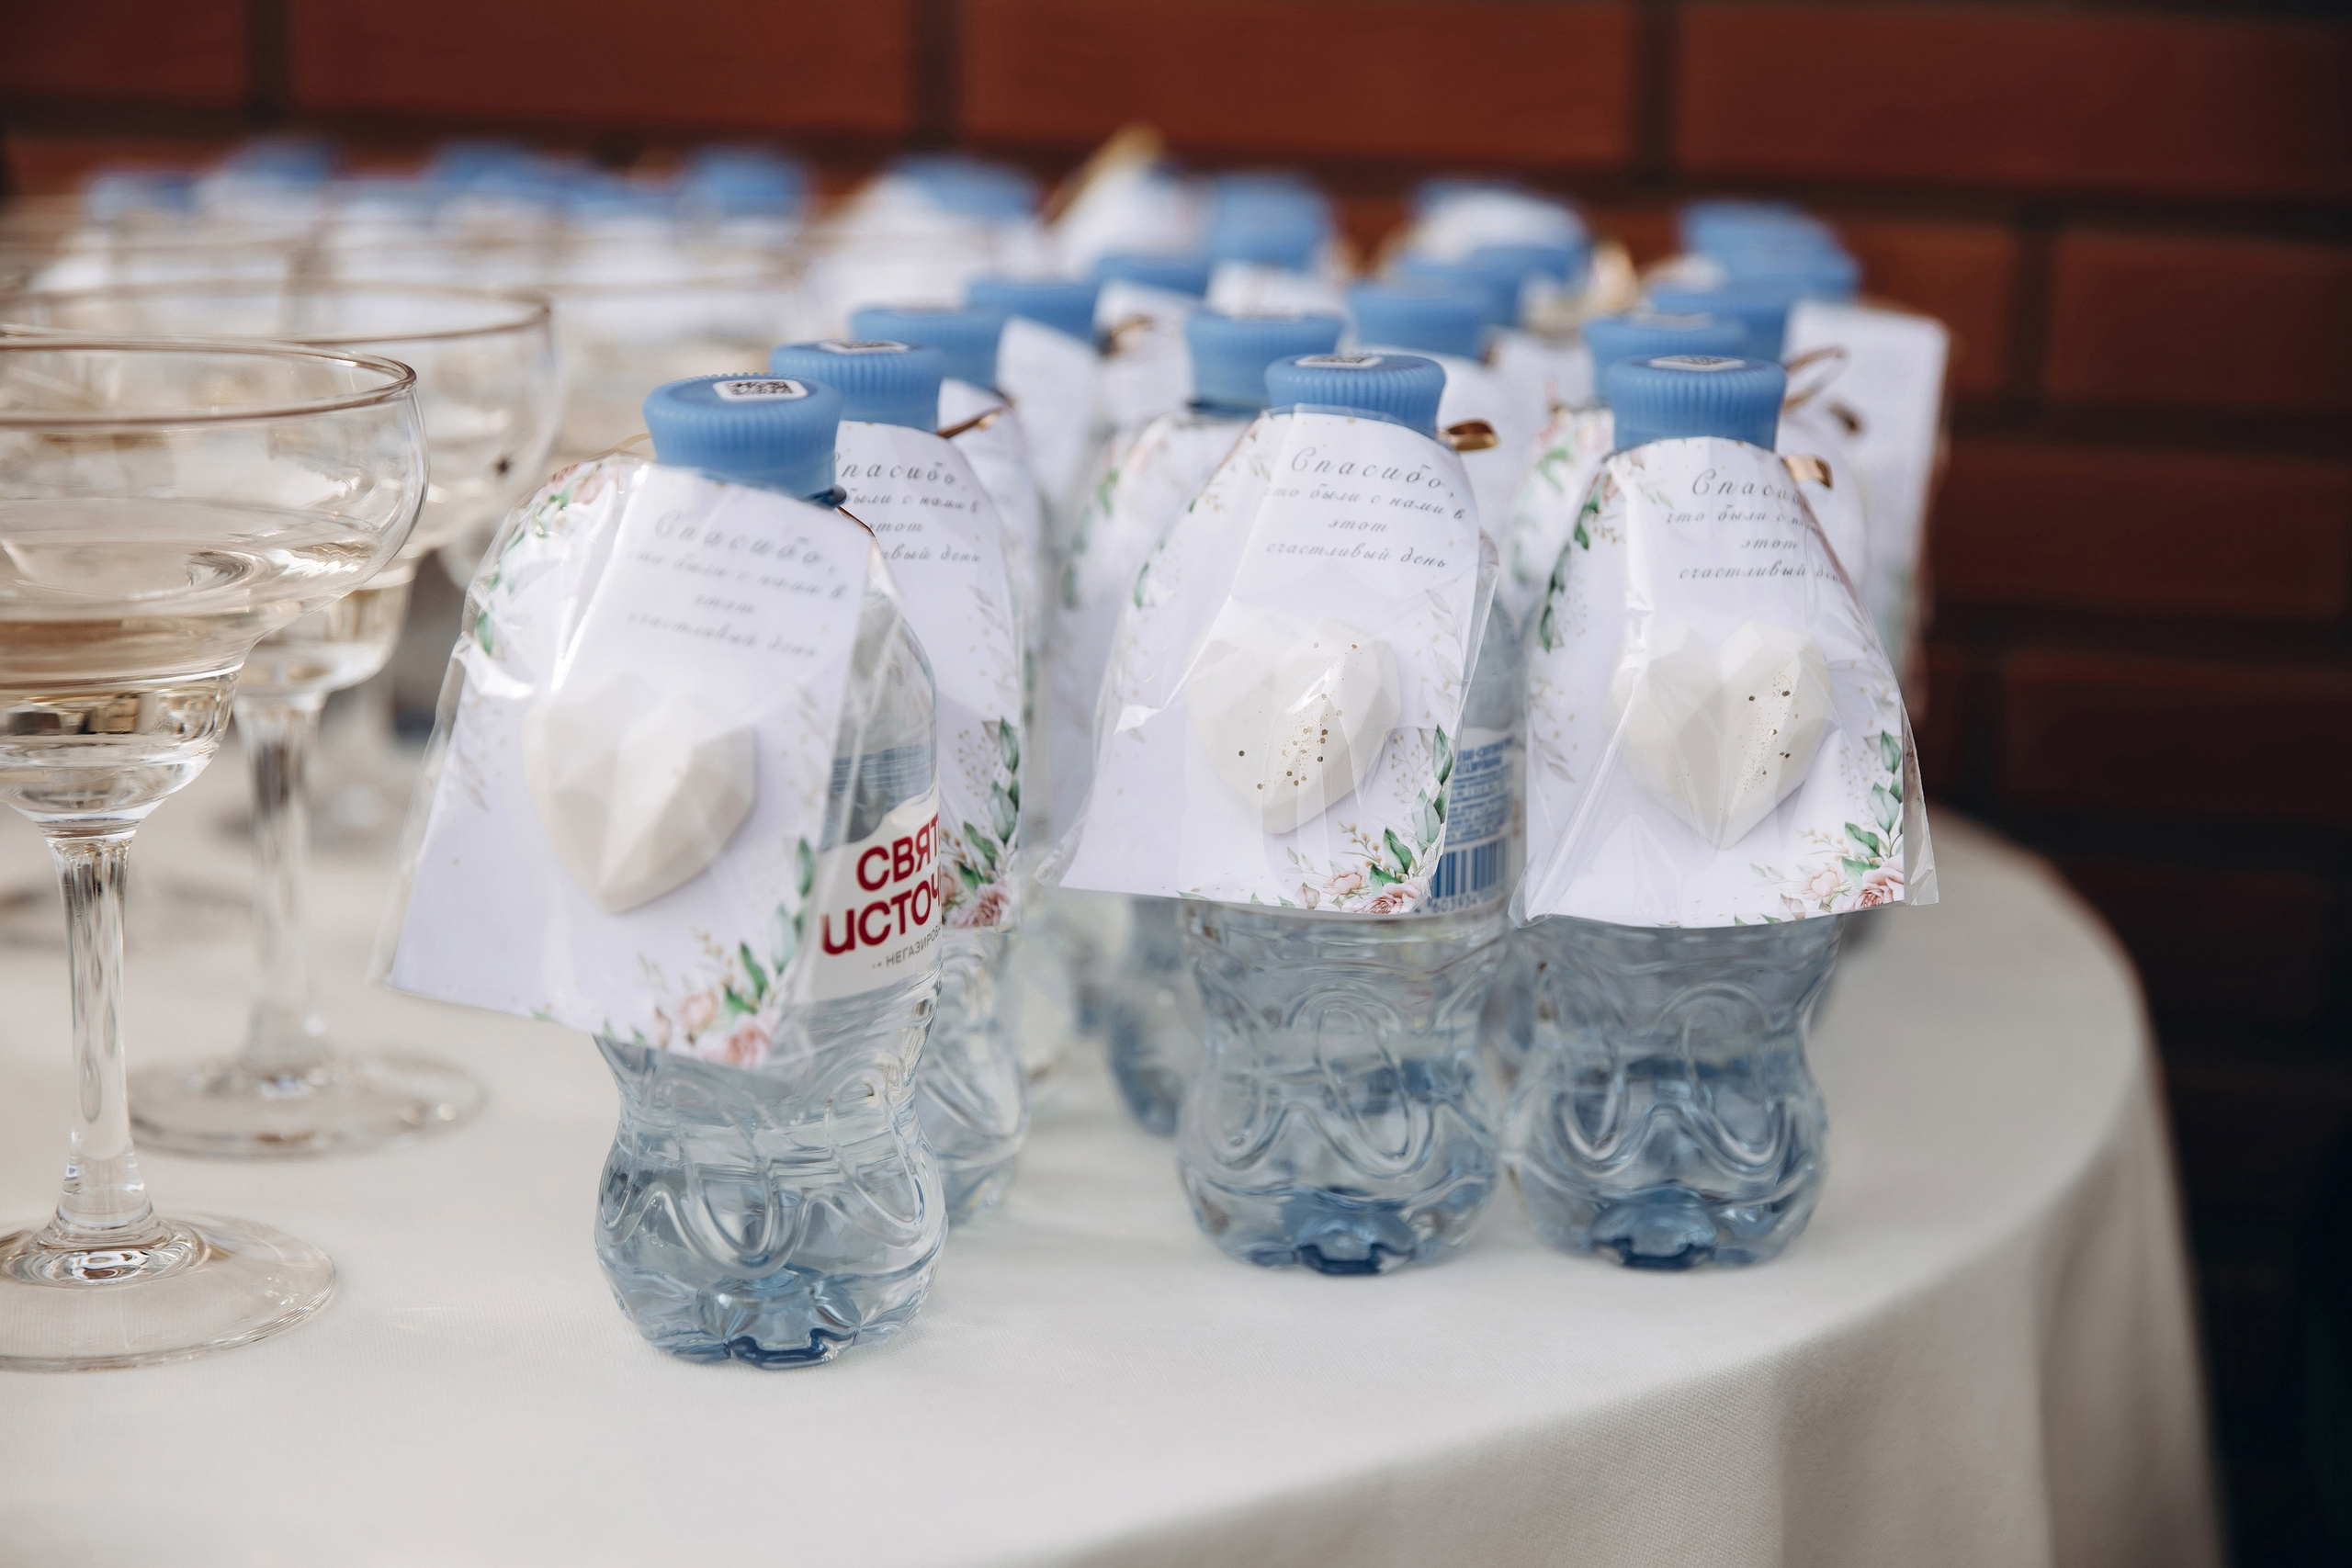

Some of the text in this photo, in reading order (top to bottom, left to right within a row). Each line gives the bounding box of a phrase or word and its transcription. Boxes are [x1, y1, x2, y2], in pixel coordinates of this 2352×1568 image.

[1291, 446, 1454, 498] Спасибо,
[901, 494, 913, 505] с
[1310, 483, 1362, 502] были
[1370, 494, 1382, 505] с
[1389, 497, 1446, 514] нами
[1453, 507, 1467, 521] в
[1717, 502, 1769, 523] были
[1327, 517, 1390, 534] этот
[1266, 542, 1450, 568] счастливый день
[1741, 538, 1799, 551] этот
